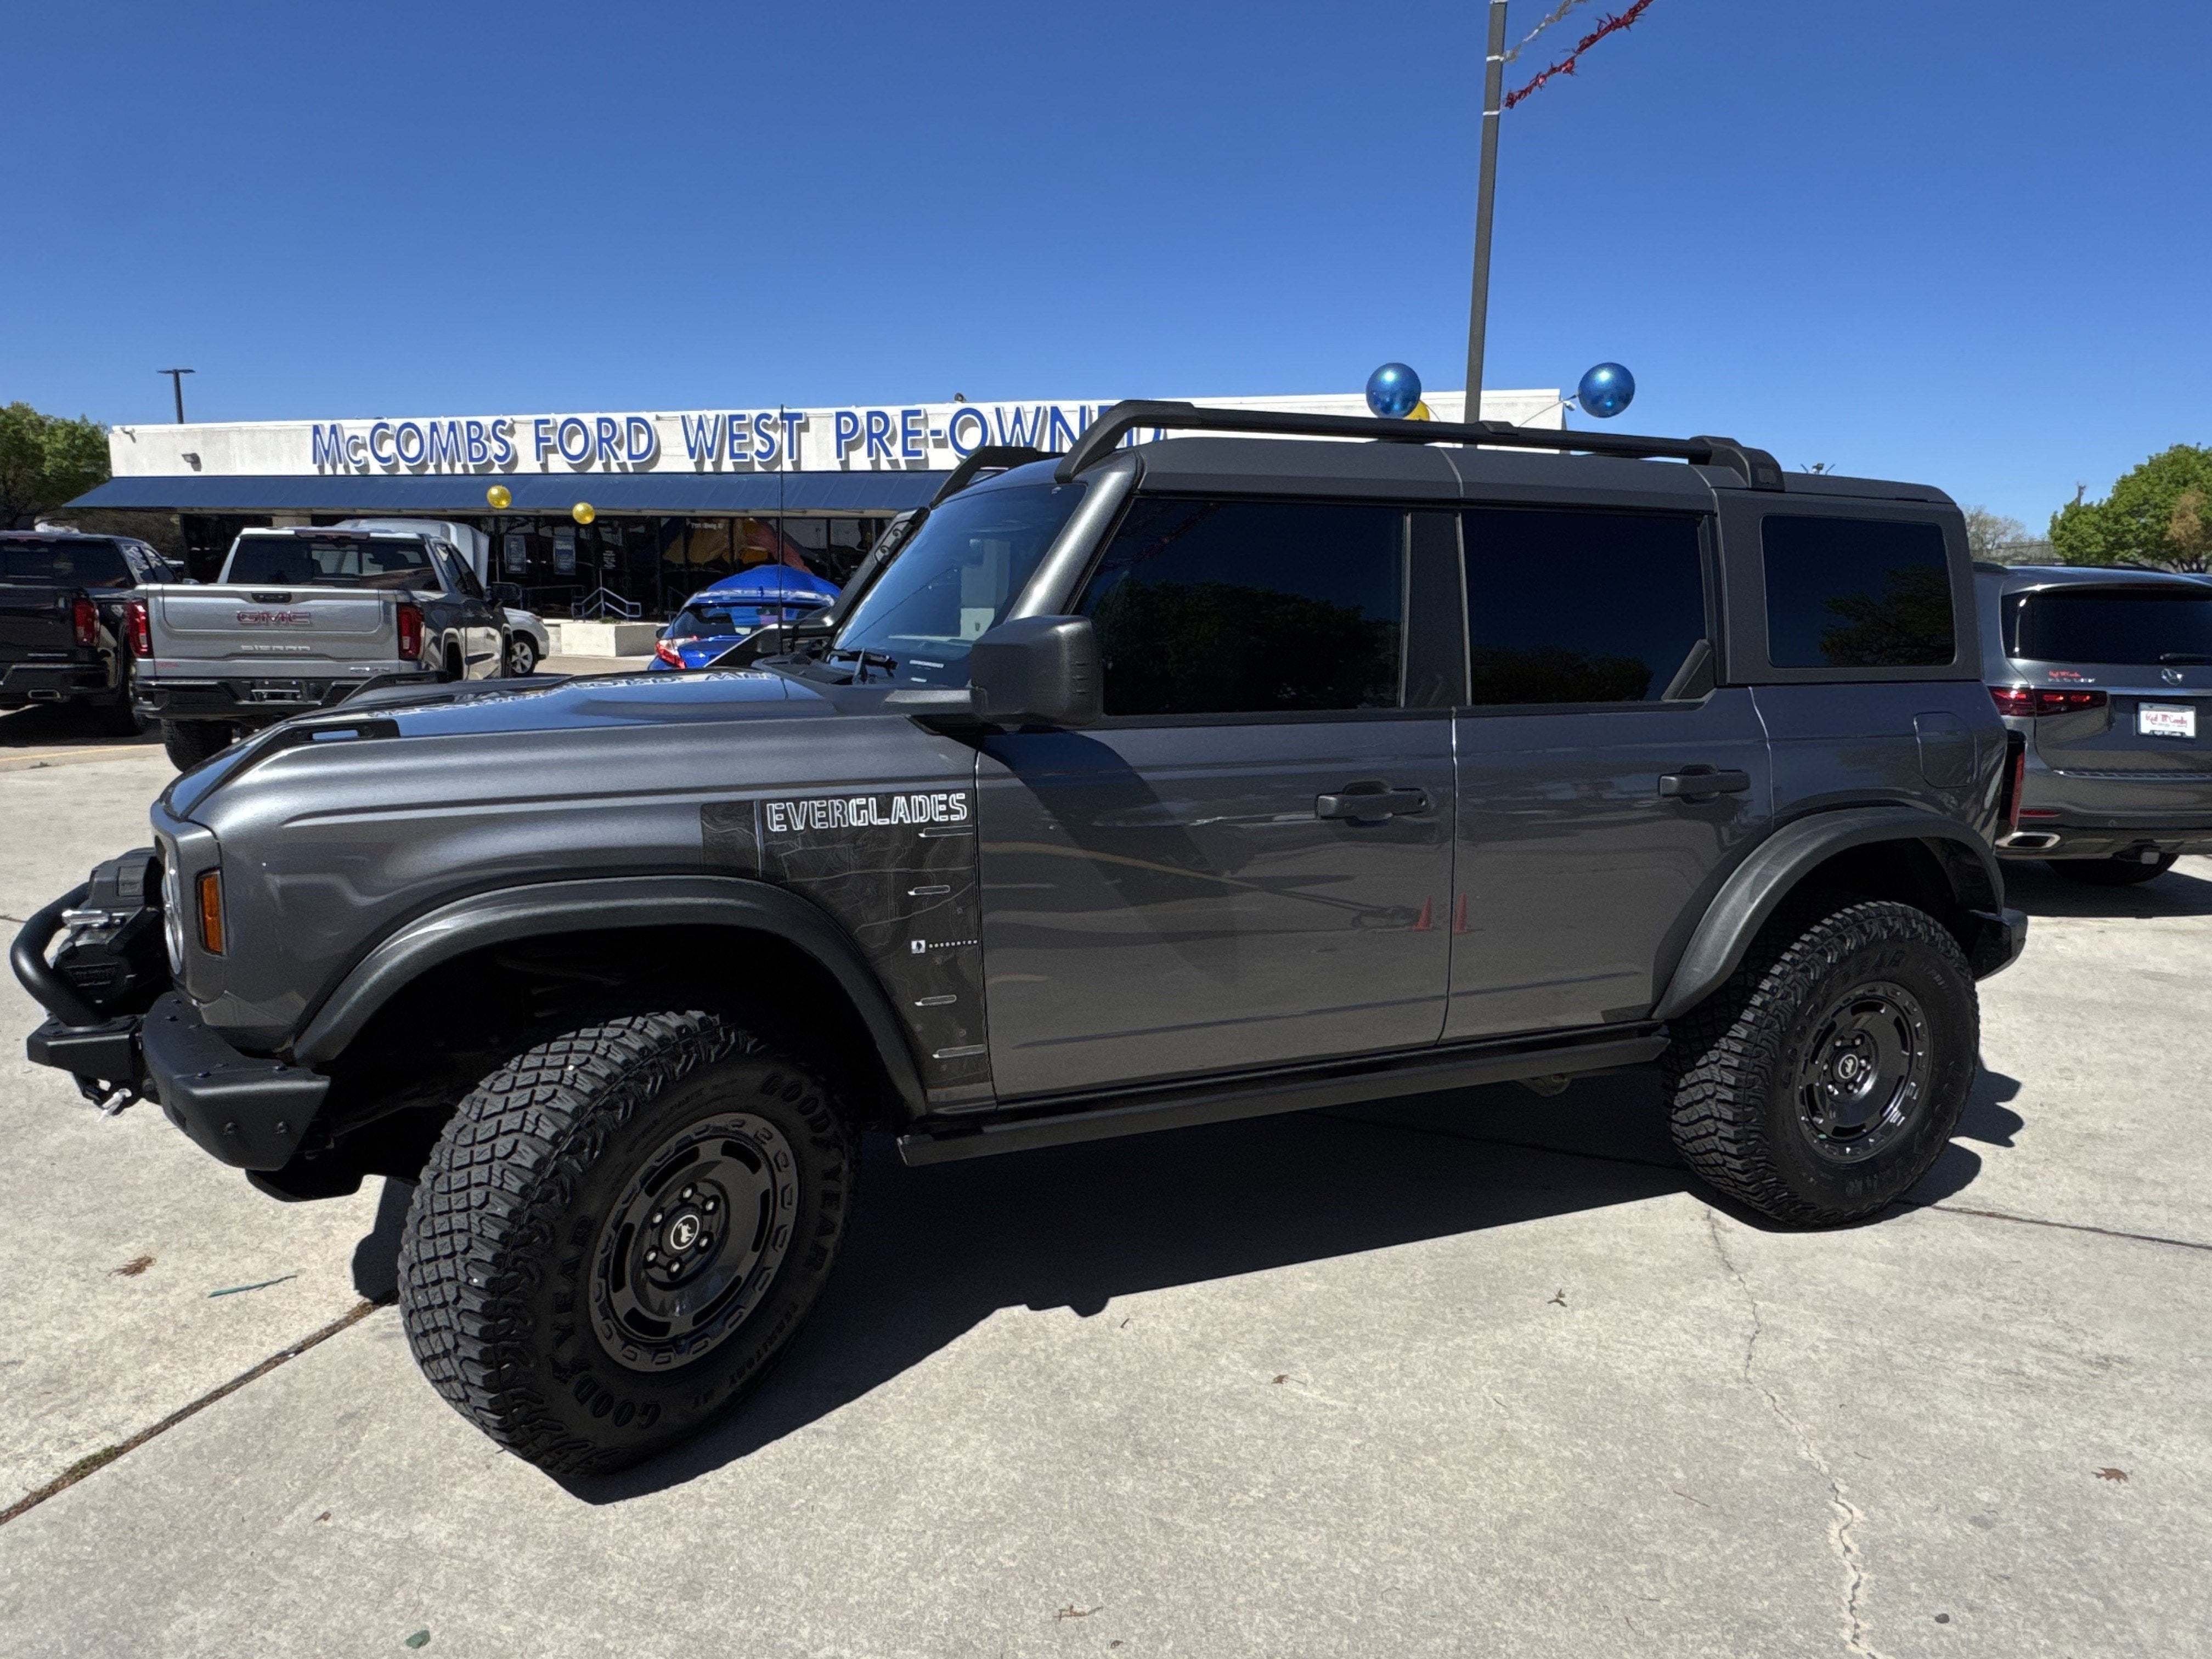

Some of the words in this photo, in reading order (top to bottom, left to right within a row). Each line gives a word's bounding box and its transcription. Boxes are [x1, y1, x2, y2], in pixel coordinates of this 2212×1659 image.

[312, 420, 514, 467] McCOMBS
[533, 417, 654, 462] FORD
[680, 412, 805, 462] WEST
[836, 405, 1162, 460] PRE-OWN
[236, 610, 311, 625] GMC
[766, 793, 968, 832] EVERGLADES
[759, 1071, 843, 1272] GOODYEAR
[549, 1215, 662, 1430] GOODYEAR
